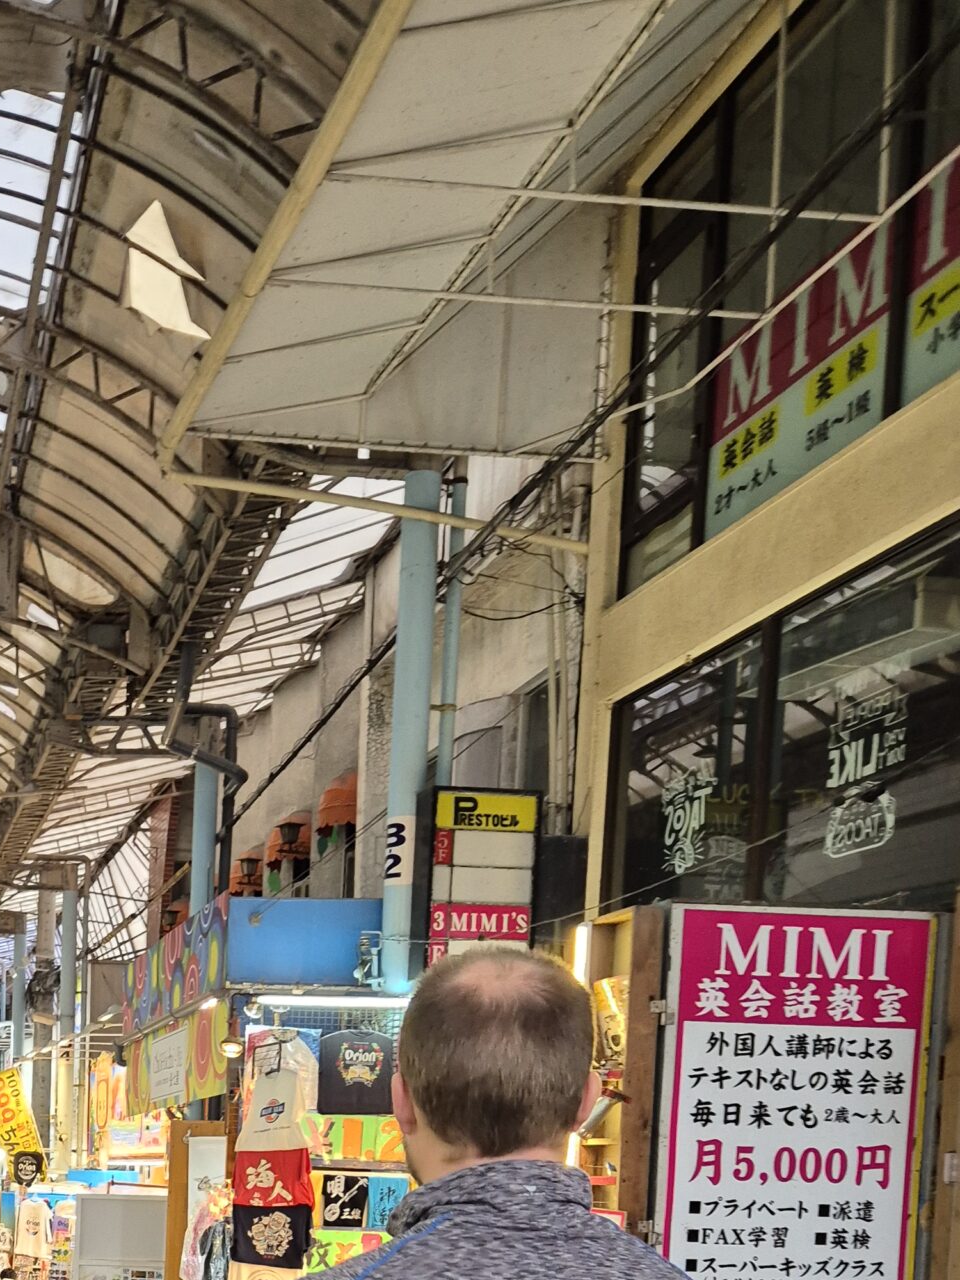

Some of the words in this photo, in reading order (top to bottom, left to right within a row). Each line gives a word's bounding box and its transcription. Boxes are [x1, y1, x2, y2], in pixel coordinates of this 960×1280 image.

[721, 411, 776, 476] 英会話
[450, 911, 529, 934] MIMI'S
[714, 923, 894, 982] MIMI
[694, 977, 910, 1024] 英会話教室
[345, 1049, 377, 1062] Orion
[705, 1031, 893, 1060] 外国人講師による
[687, 1067, 907, 1096] テキストなしの英会話
[689, 1100, 819, 1129] 毎日来ても
[688, 1138, 892, 1190] 月5,000円
[246, 1159, 293, 1202] 海人
[703, 1196, 809, 1220] プライベート
[833, 1200, 876, 1223] 派遣
[701, 1227, 789, 1248] FAX学習
[830, 1228, 872, 1250] 英検
[700, 1256, 885, 1278] スーパーキッズクラス
